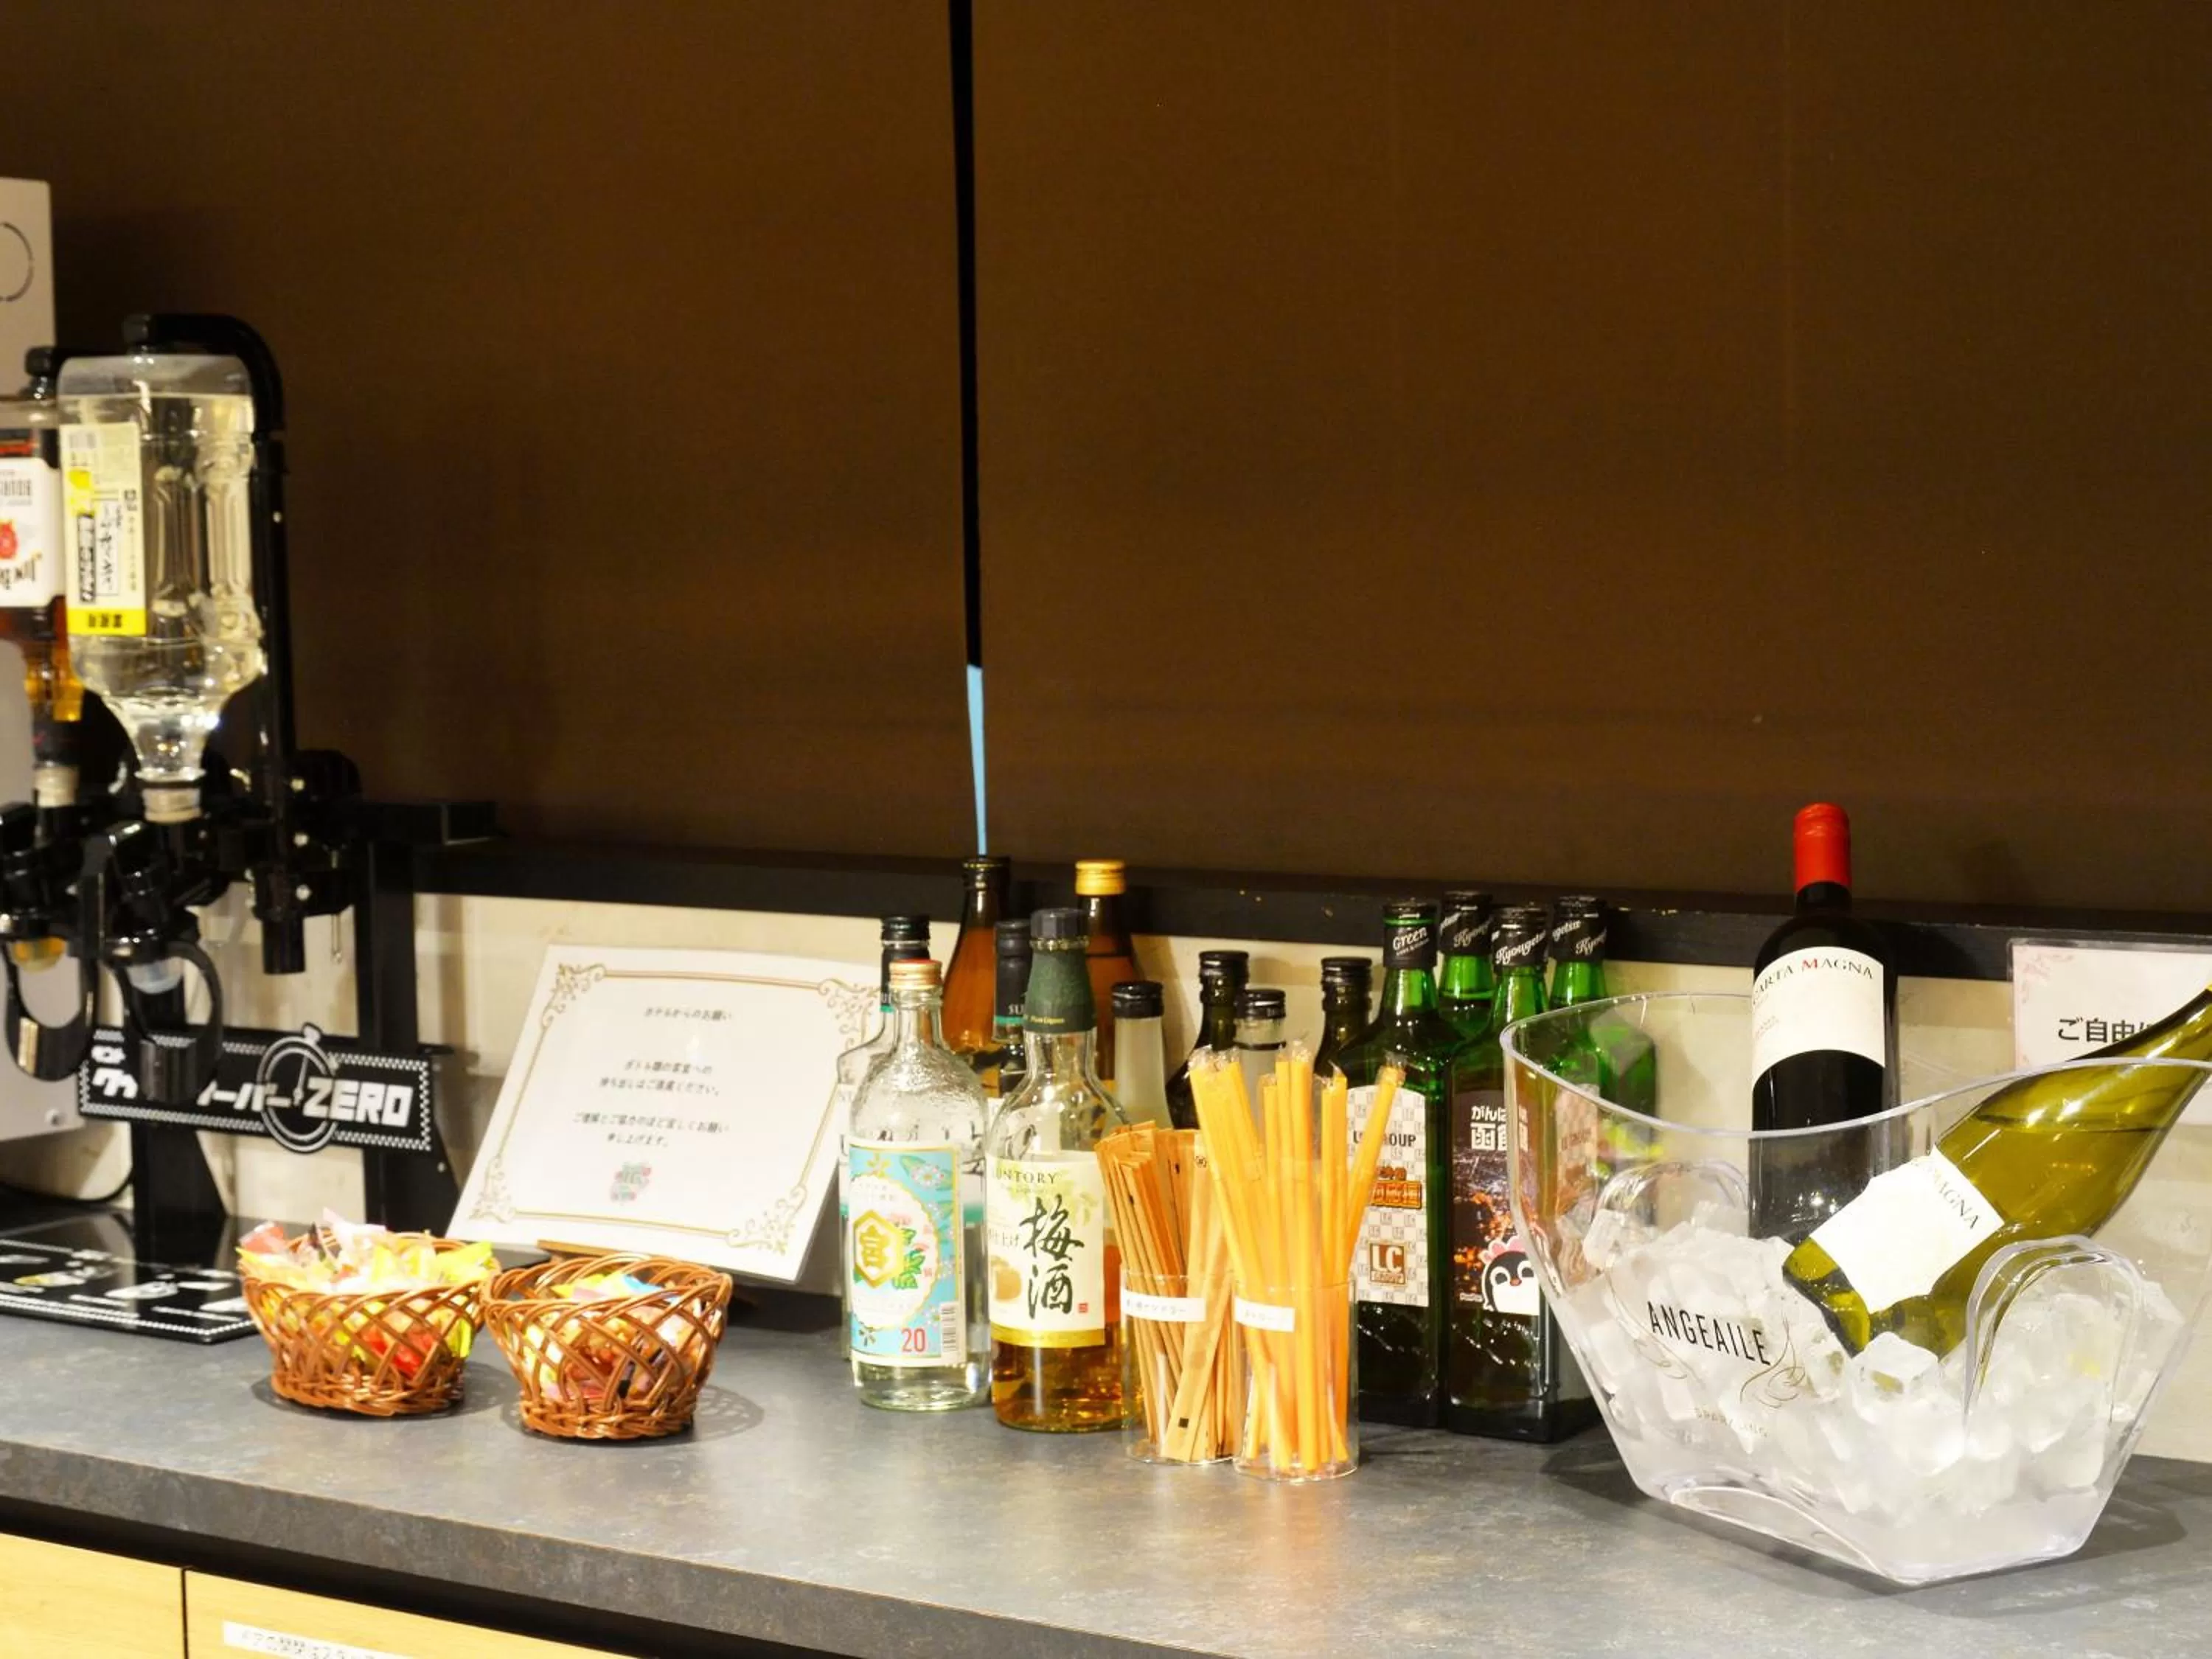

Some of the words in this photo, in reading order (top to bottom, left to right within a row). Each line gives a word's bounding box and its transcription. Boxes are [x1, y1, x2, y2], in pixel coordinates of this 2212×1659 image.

[1393, 927, 1427, 950] Green
[1802, 958, 1874, 980] MAGNA
[303, 1076, 414, 1127] ZERO
[1019, 1193, 1085, 1320] 梅酒
[1372, 1245, 1402, 1273] LC
[901, 1328, 927, 1353] 20
[1646, 1300, 1772, 1366] ANGEAILE
